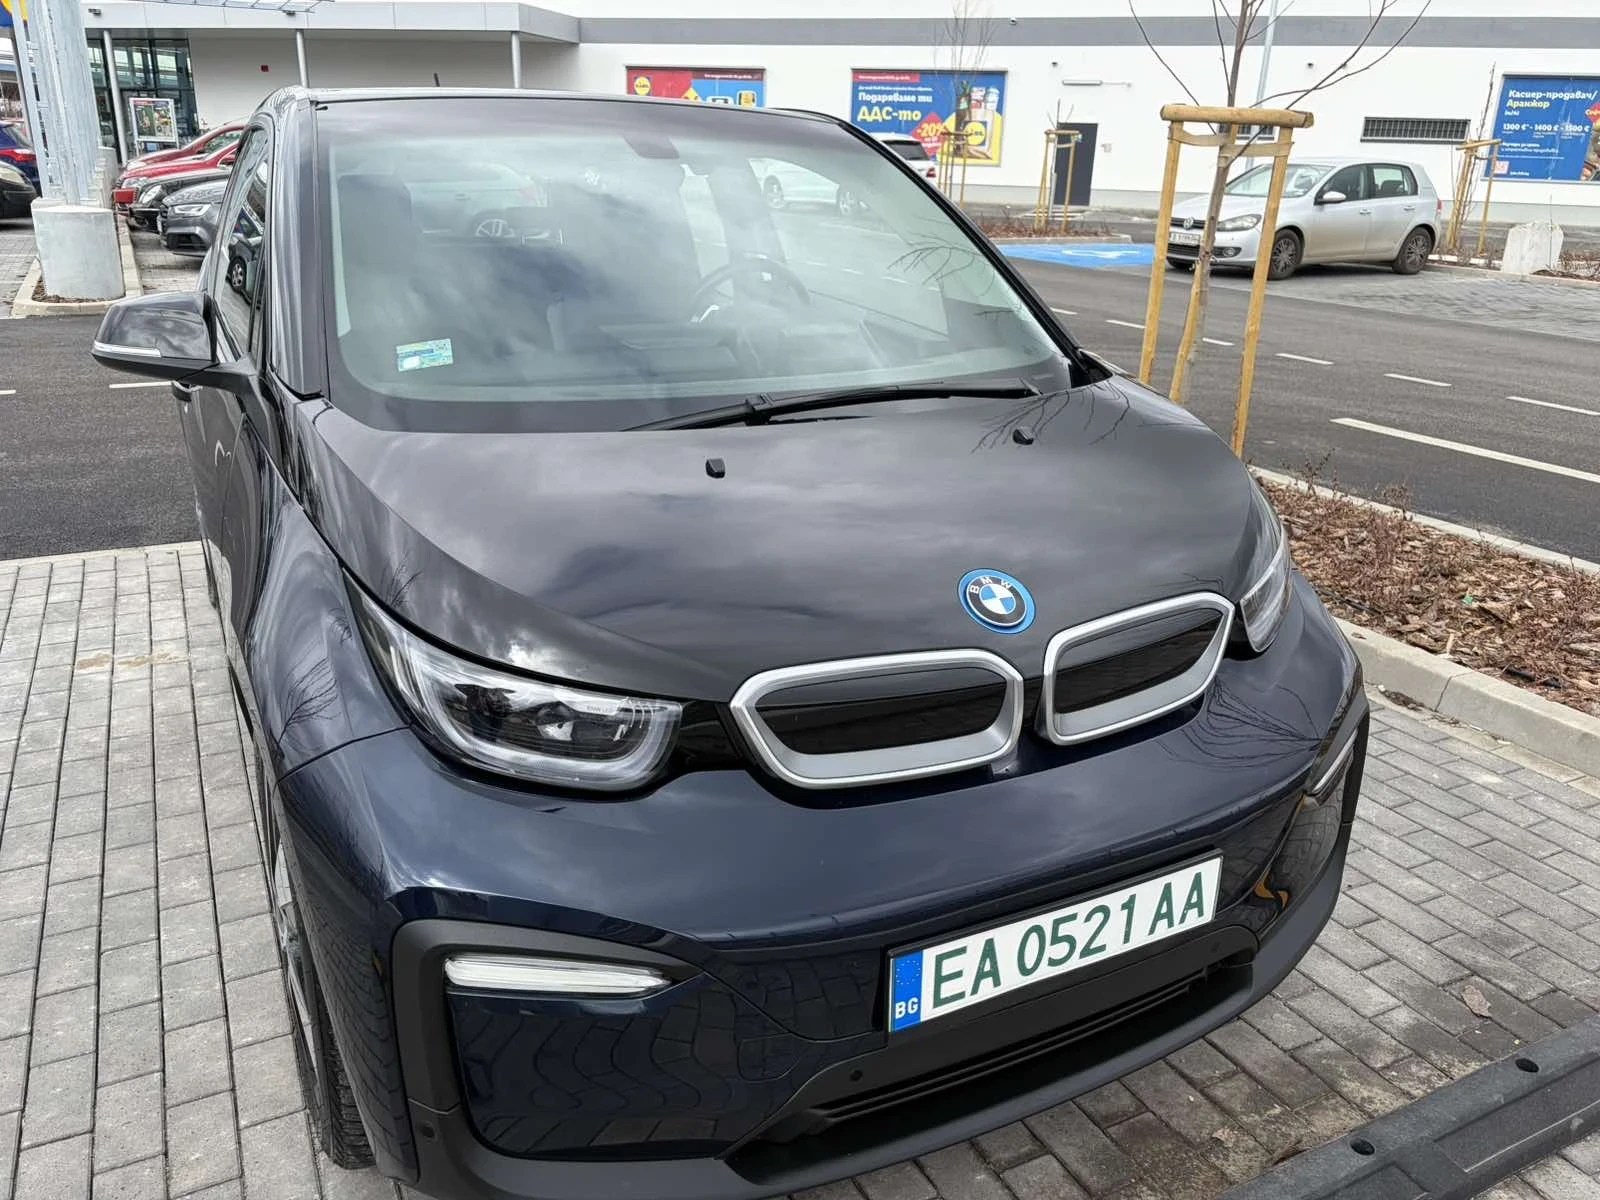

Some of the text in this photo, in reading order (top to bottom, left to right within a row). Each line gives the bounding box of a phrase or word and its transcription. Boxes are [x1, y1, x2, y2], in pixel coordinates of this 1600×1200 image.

[858, 91, 933, 104] Подаряваме ти
[1506, 99, 1551, 109] Аранжор
[857, 105, 922, 122] ДДС-то
[1503, 123, 1520, 131] 1300
[1534, 124, 1553, 132] 1400
[969, 576, 1012, 594] BMW
[932, 871, 1205, 1009] EA 0521 AA
[895, 997, 919, 1020] BG
